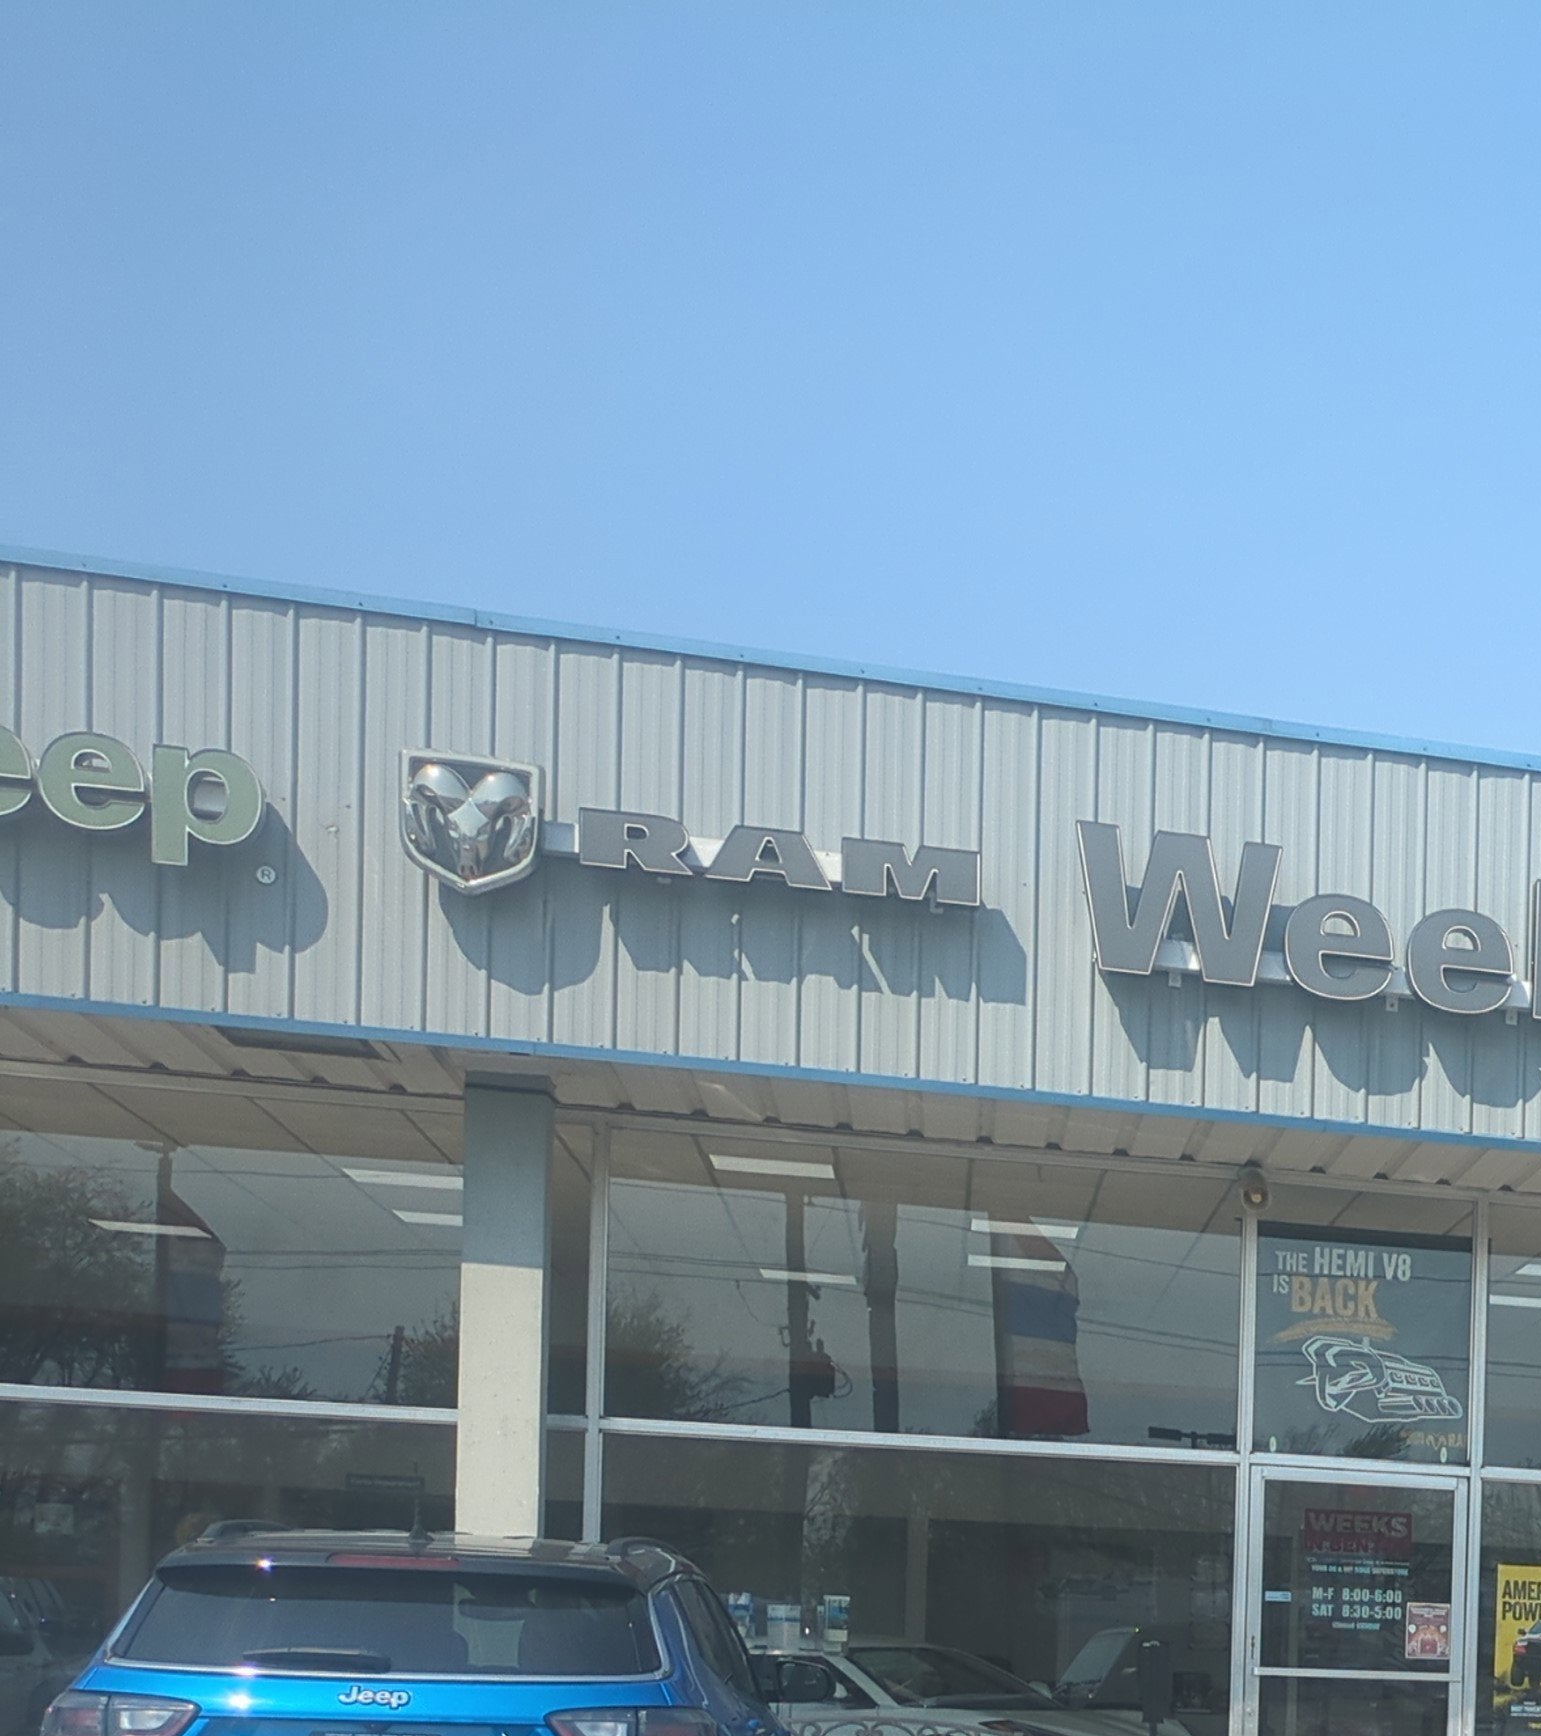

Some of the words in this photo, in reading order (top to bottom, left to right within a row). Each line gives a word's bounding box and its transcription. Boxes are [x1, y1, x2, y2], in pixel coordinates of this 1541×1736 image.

[577, 806, 981, 907] RAM
[1275, 1250, 1308, 1273] THE
[1313, 1247, 1375, 1279] HEMI
[1382, 1251, 1412, 1282] V8
[1273, 1274, 1290, 1294] IS
[1290, 1277, 1380, 1320] BACK
[1307, 1512, 1408, 1538] WEEKS
[1311, 1586, 1335, 1600] M-F
[1311, 1603, 1335, 1617] SAT
[337, 1685, 411, 1709] Jeep
